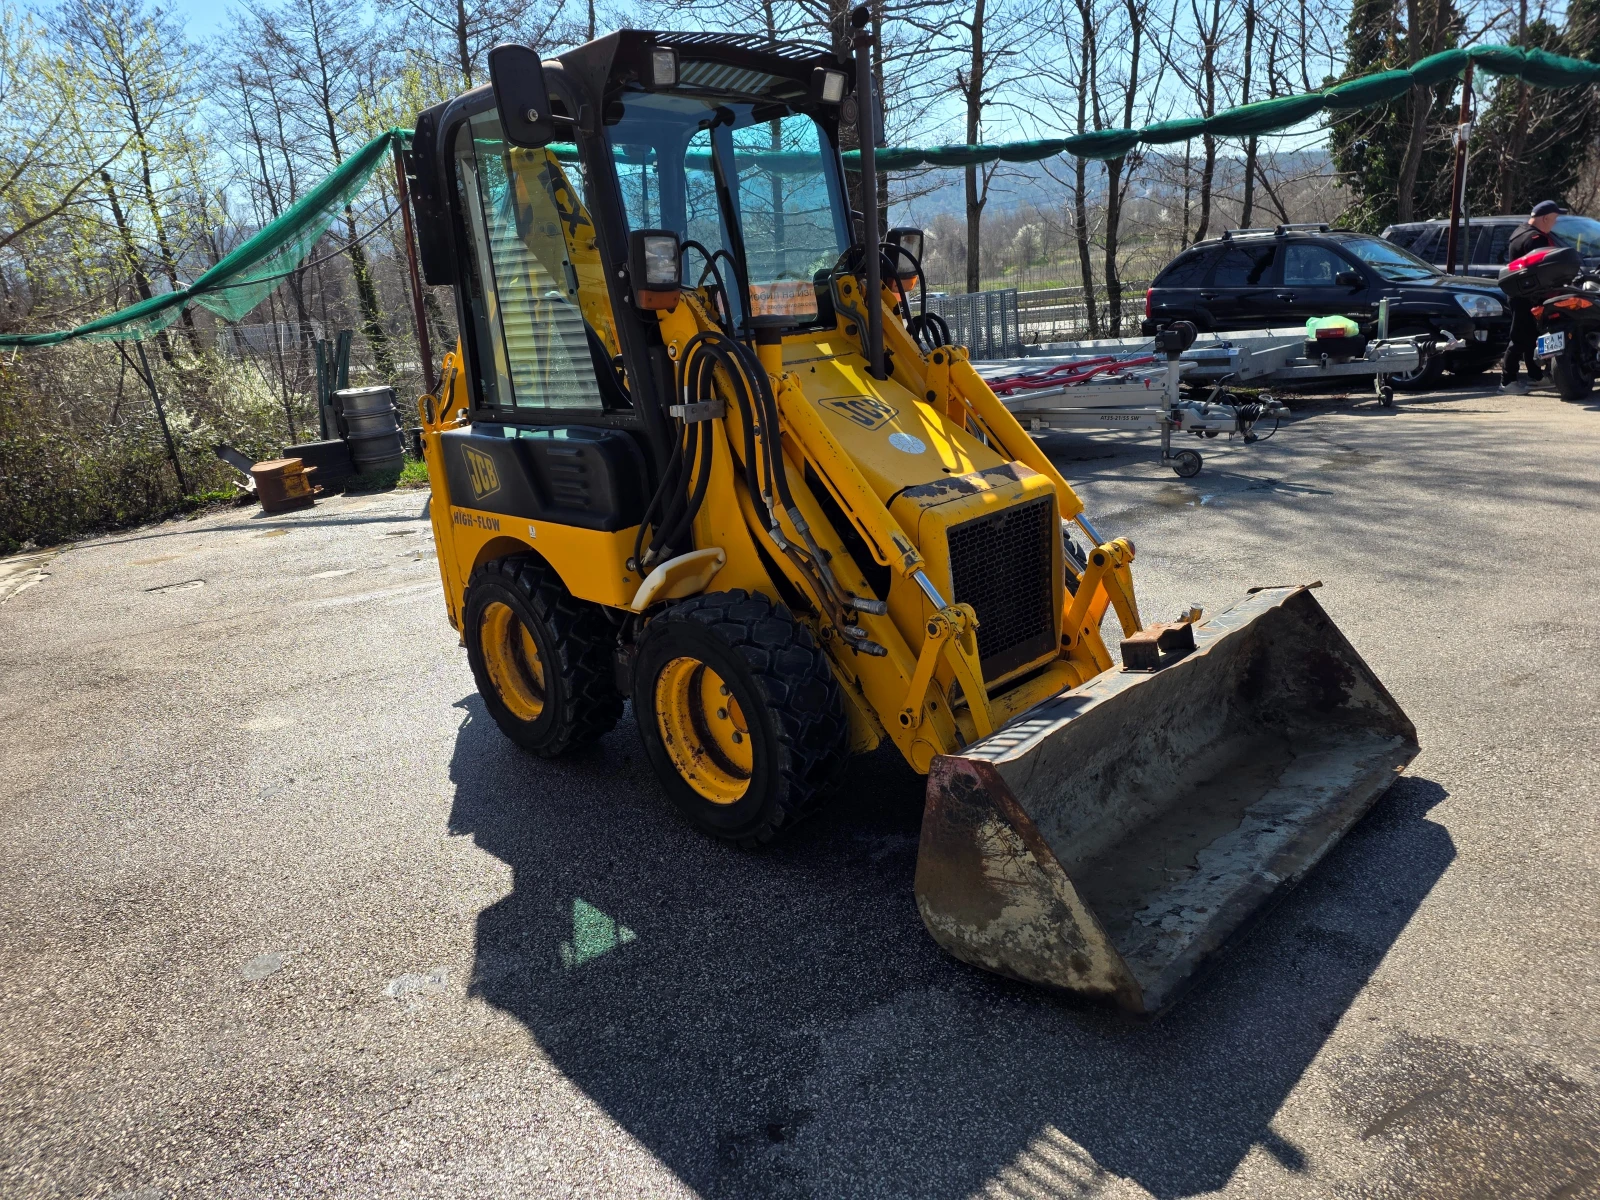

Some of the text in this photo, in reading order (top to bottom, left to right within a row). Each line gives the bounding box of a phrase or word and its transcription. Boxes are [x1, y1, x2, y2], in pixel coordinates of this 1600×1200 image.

[830, 399, 891, 426] JCB
[467, 451, 498, 494] JCB
[454, 511, 500, 531] HIGH-FLOW
